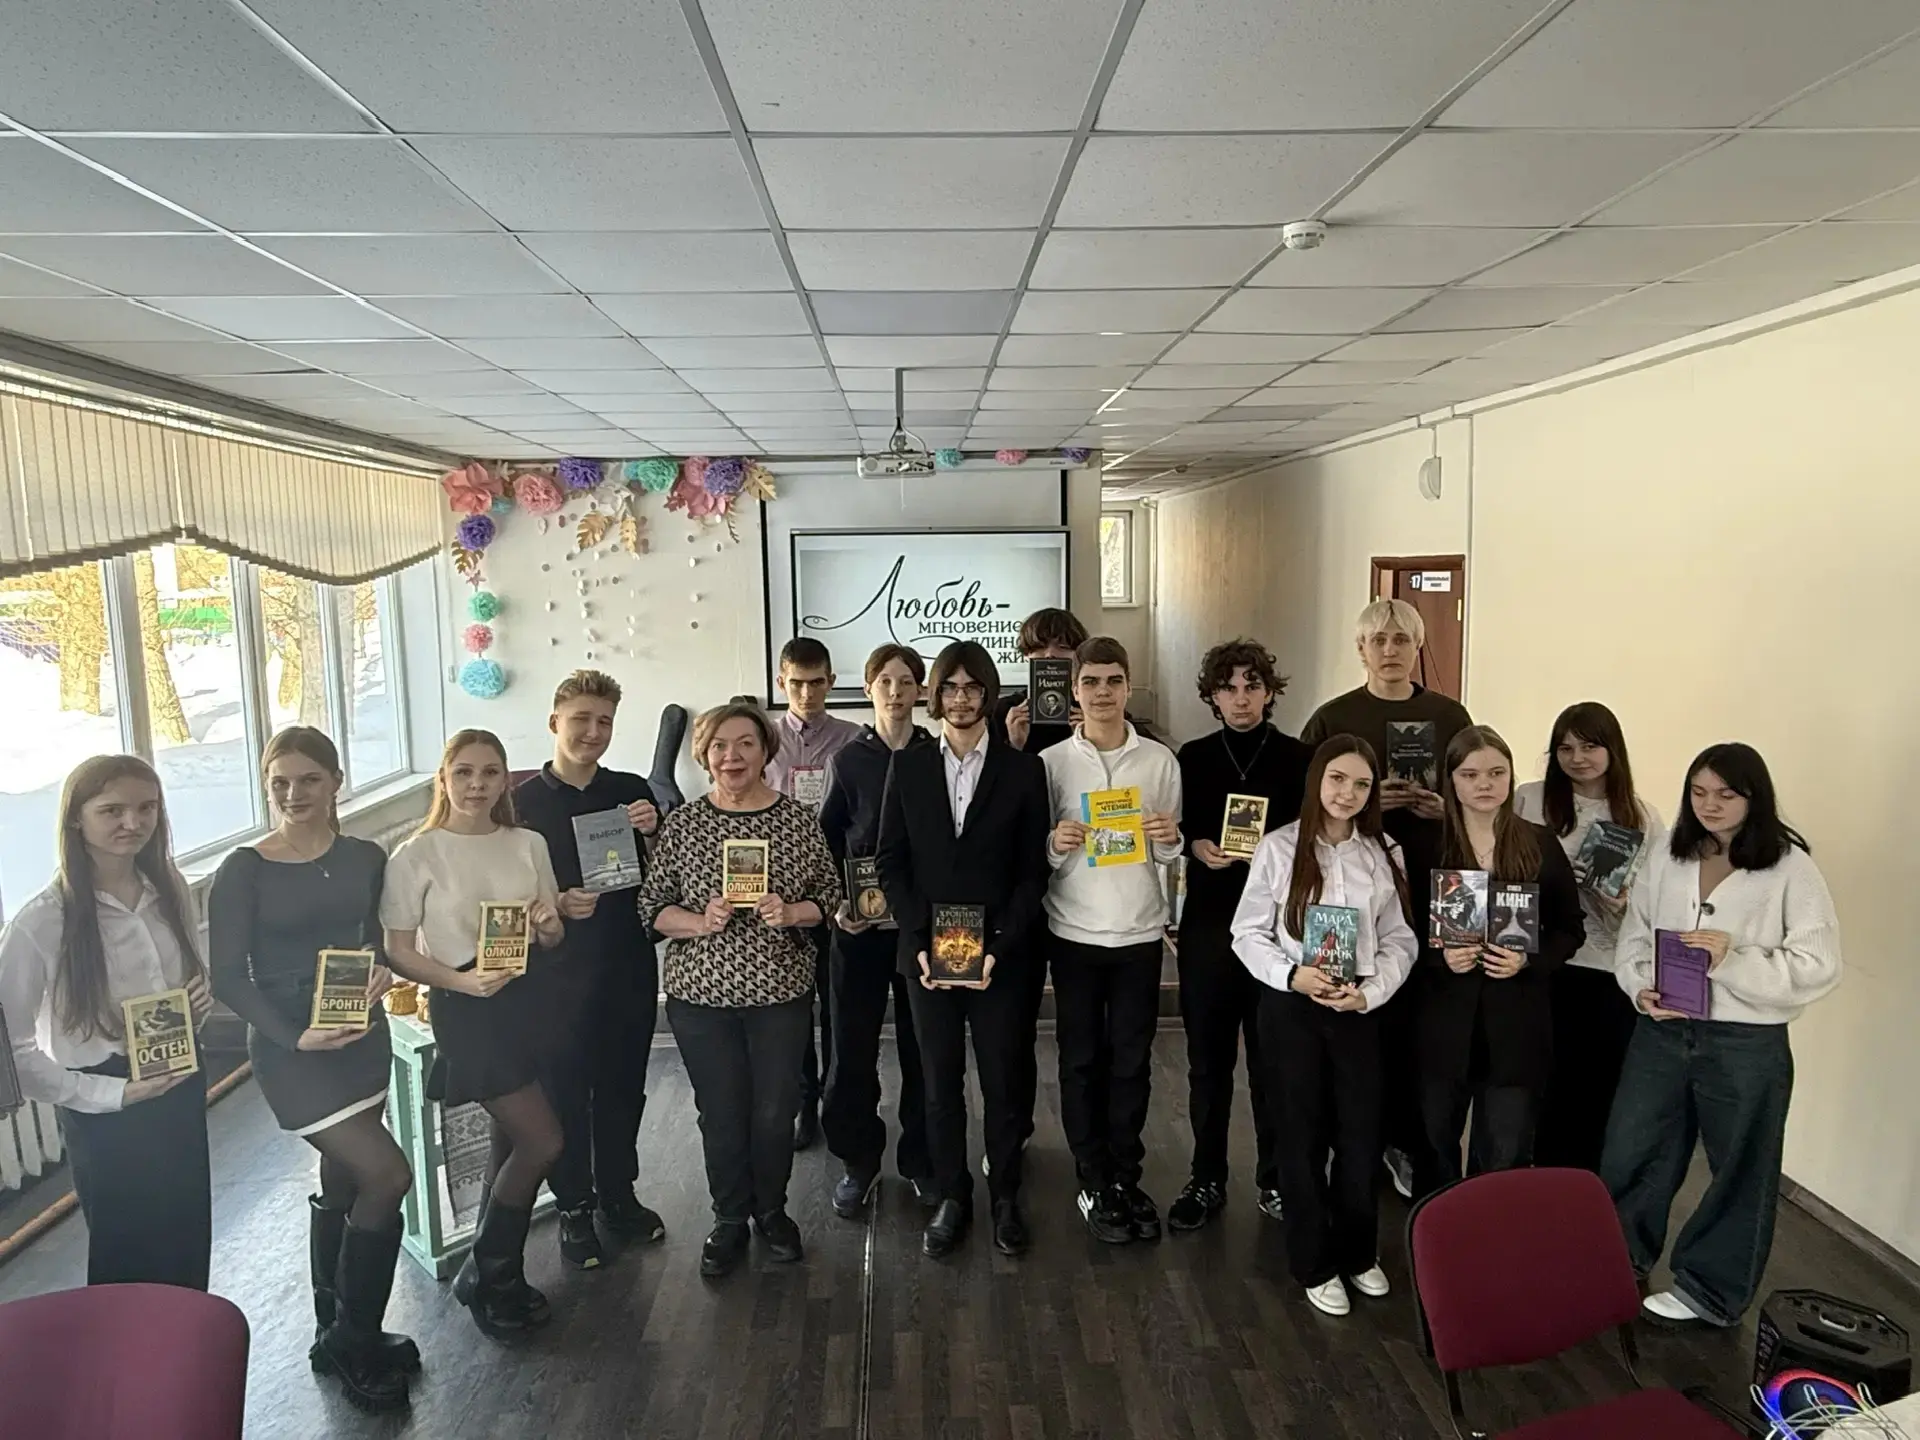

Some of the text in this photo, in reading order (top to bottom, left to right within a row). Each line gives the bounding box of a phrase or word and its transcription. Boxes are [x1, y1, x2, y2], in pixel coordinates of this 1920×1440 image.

[803, 555, 1011, 647] Любовь-
[918, 620, 1023, 634] мгновение
[996, 652, 1029, 663] жи
[1101, 803, 1133, 811] ЧТЕНИЕ
[589, 828, 625, 841] ВЫБОР
[727, 882, 764, 892] ОЛКОТТ
[1496, 892, 1533, 908] КИНГ
[485, 946, 524, 958] ОЛКОТТ
[321, 998, 365, 1010] БРОНТЕ
[138, 1039, 189, 1065] ОСТЕН
